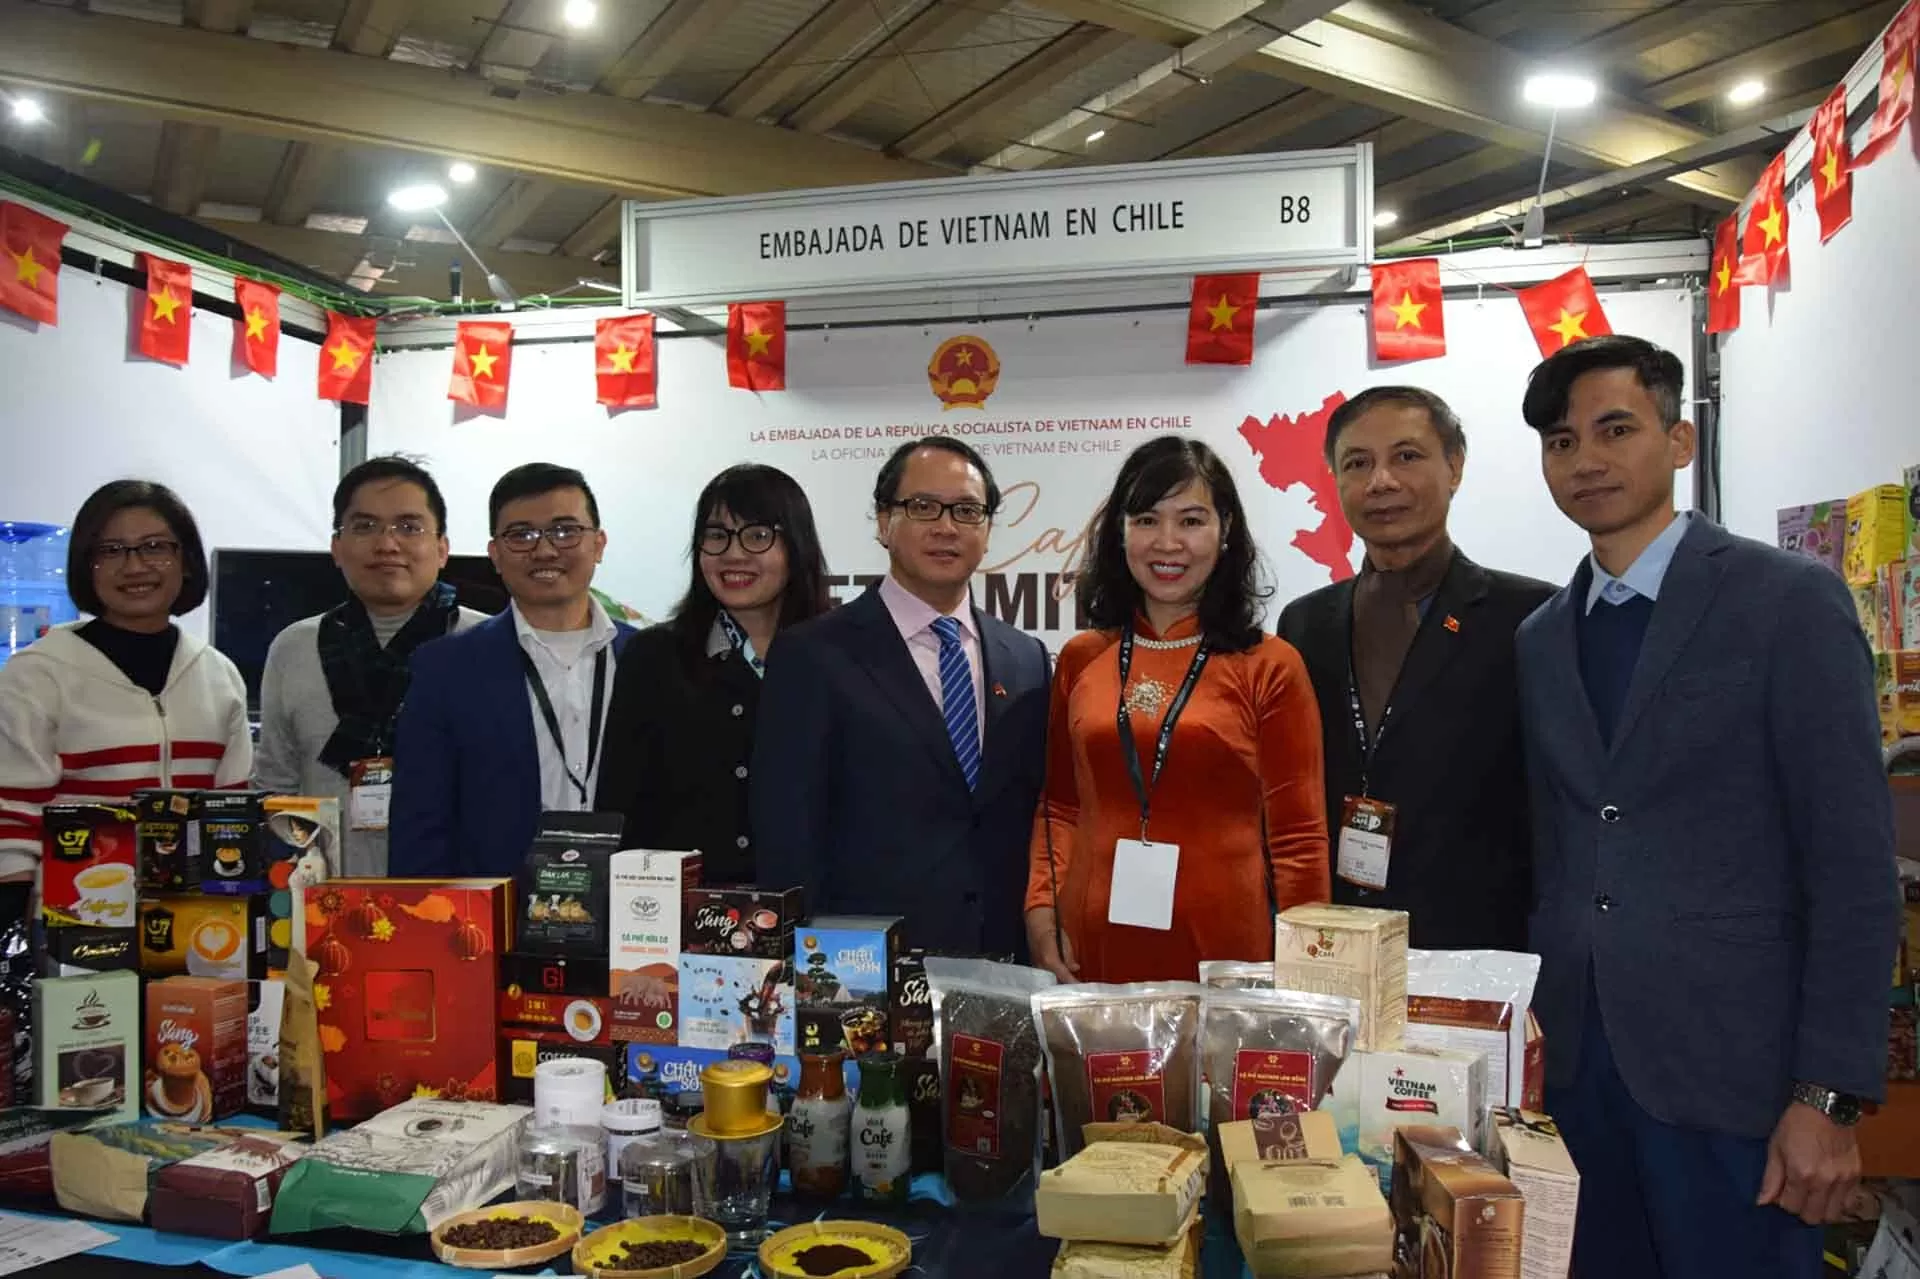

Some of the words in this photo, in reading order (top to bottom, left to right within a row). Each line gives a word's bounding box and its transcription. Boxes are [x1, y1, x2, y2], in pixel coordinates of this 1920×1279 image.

[1280, 195, 1311, 224] B8
[760, 224, 885, 259] EMBAJADA
[899, 220, 929, 248] DE
[940, 210, 1050, 245] VIETNAM
[1066, 207, 1096, 236] EN
[1112, 201, 1184, 233] CHILE
[750, 431, 765, 442] LA
[769, 427, 841, 441] EMBAJADA
[844, 427, 863, 439] DE
[865, 426, 882, 438] LA
[953, 420, 1032, 436] SOCIALISTA
[1035, 420, 1057, 432] DE
[1058, 418, 1122, 431] VIETNAM
[1127, 416, 1147, 429] EN
[1150, 415, 1192, 428] CHILE
[812, 448, 828, 460] LA
[830, 446, 885, 460] OFICINA
[994, 441, 1057, 455] VIETNAM
[1059, 441, 1078, 453] EN
[1081, 439, 1121, 452] CHILE
[1388, 1077, 1436, 1092] VIETNAM
[1393, 1087, 1430, 1099] COFFEE
